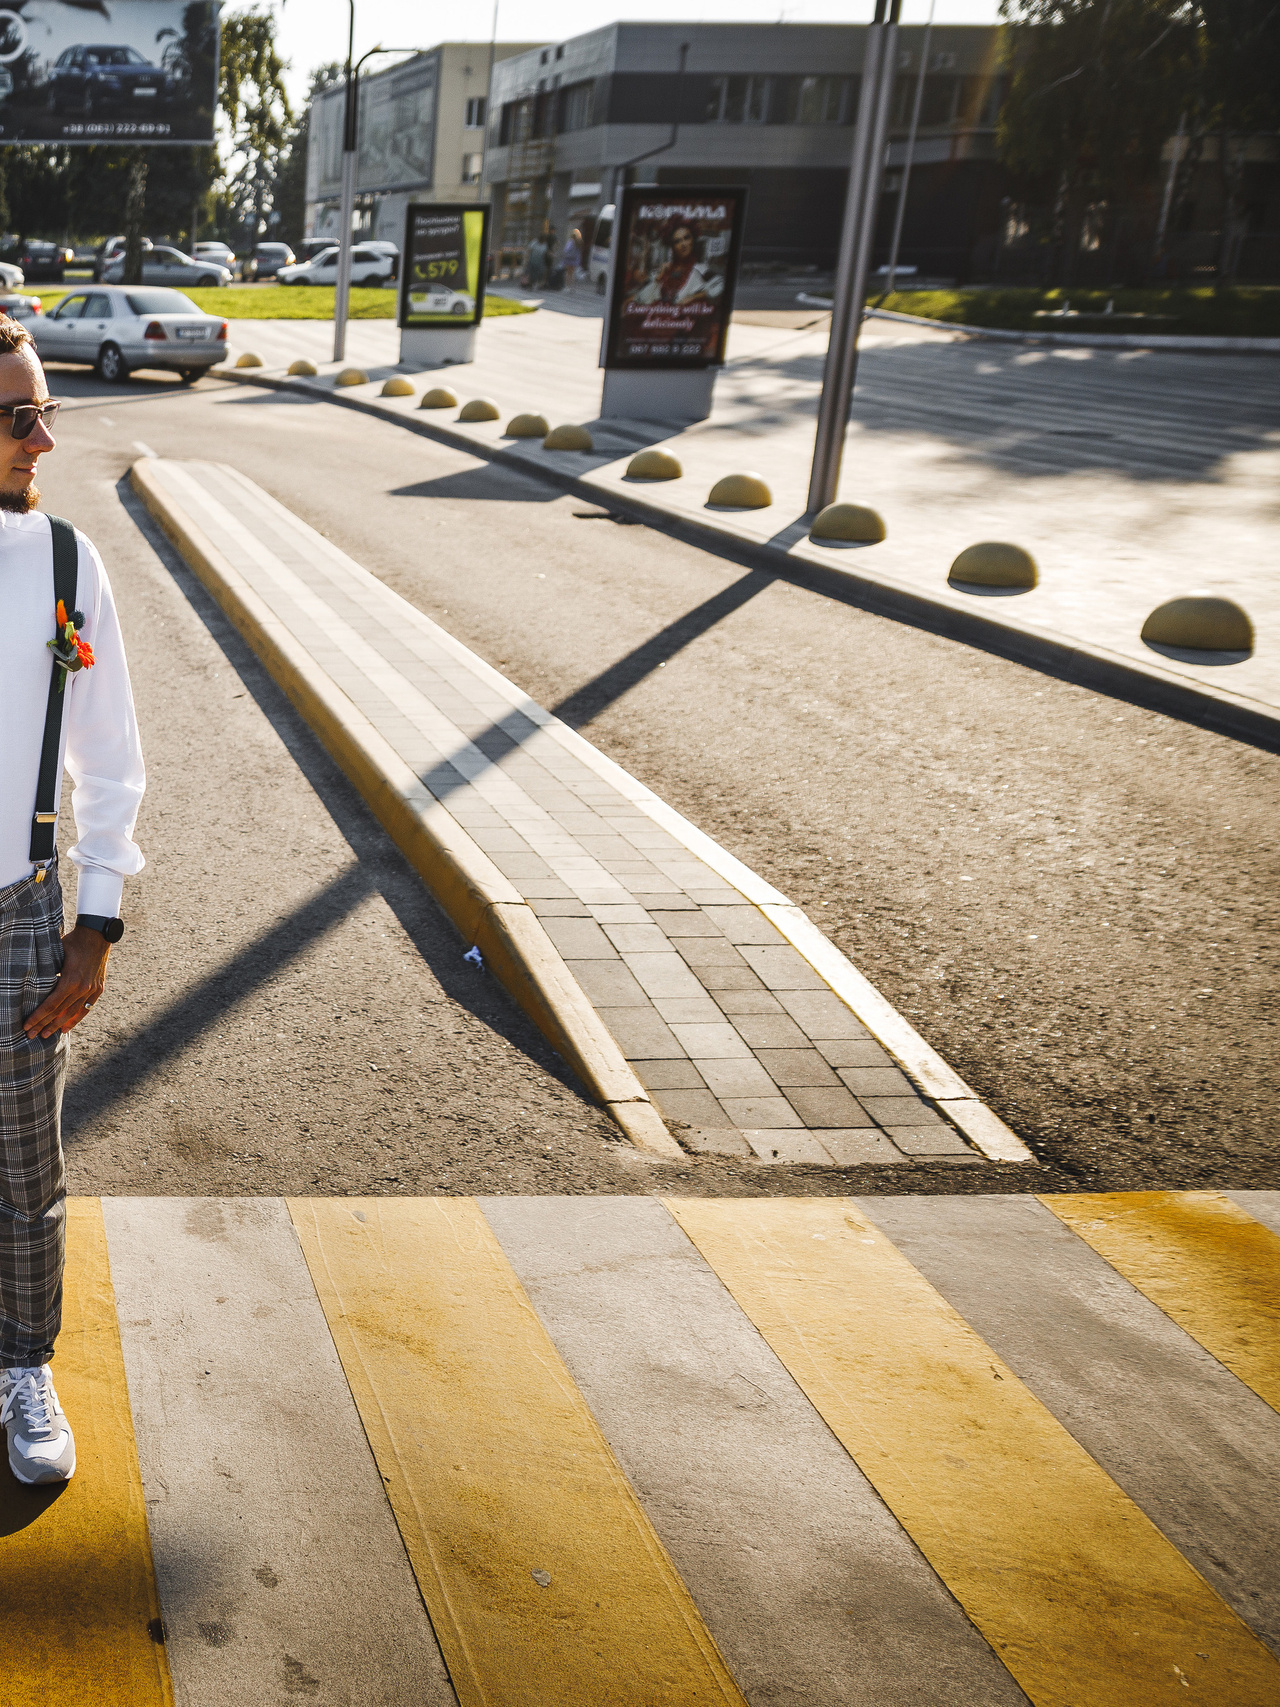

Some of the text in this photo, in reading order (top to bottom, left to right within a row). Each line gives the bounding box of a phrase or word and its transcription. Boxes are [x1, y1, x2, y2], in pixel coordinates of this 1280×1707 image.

[428, 260, 459, 279] 579
[626, 302, 680, 318] Everything
[682, 303, 699, 314] will
